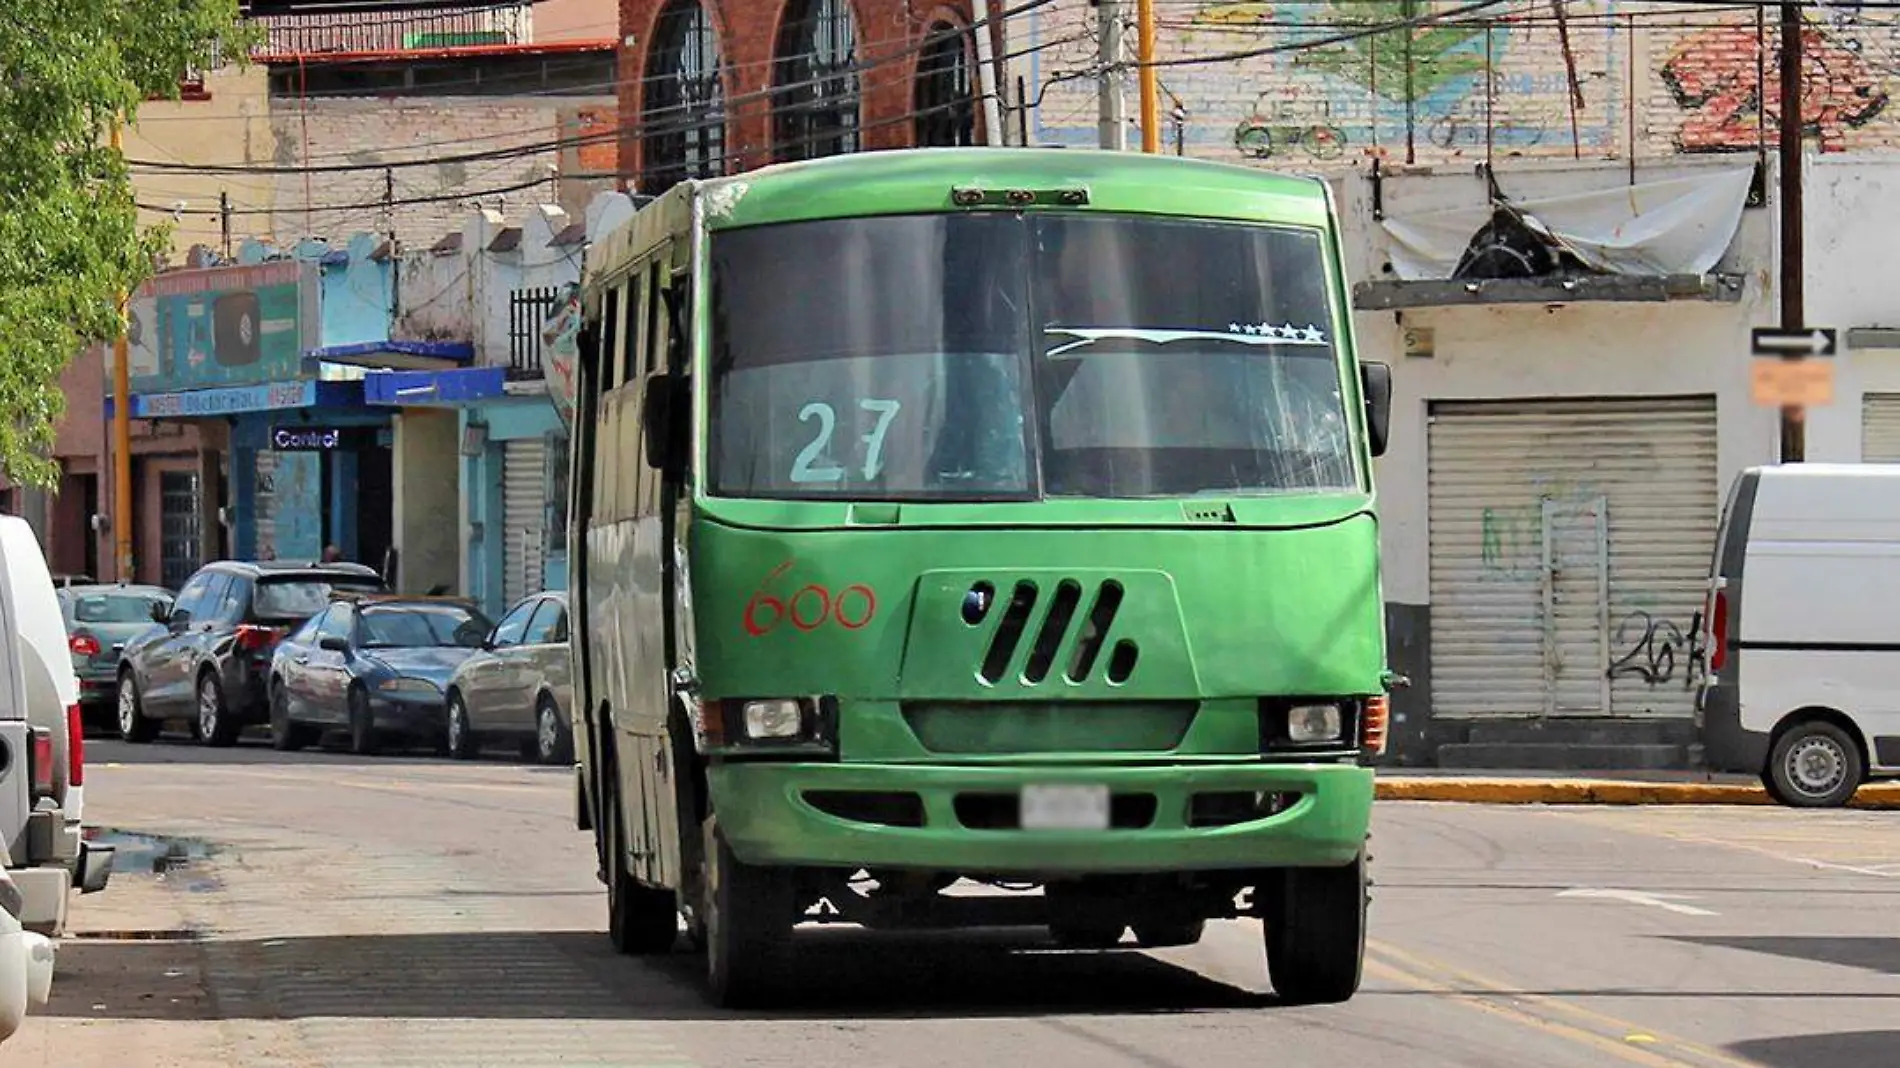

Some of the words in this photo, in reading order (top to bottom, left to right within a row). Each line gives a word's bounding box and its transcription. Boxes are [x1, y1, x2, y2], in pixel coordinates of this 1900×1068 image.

[274, 429, 339, 448] Control
[790, 399, 900, 482] 27
[743, 560, 876, 637] 600
